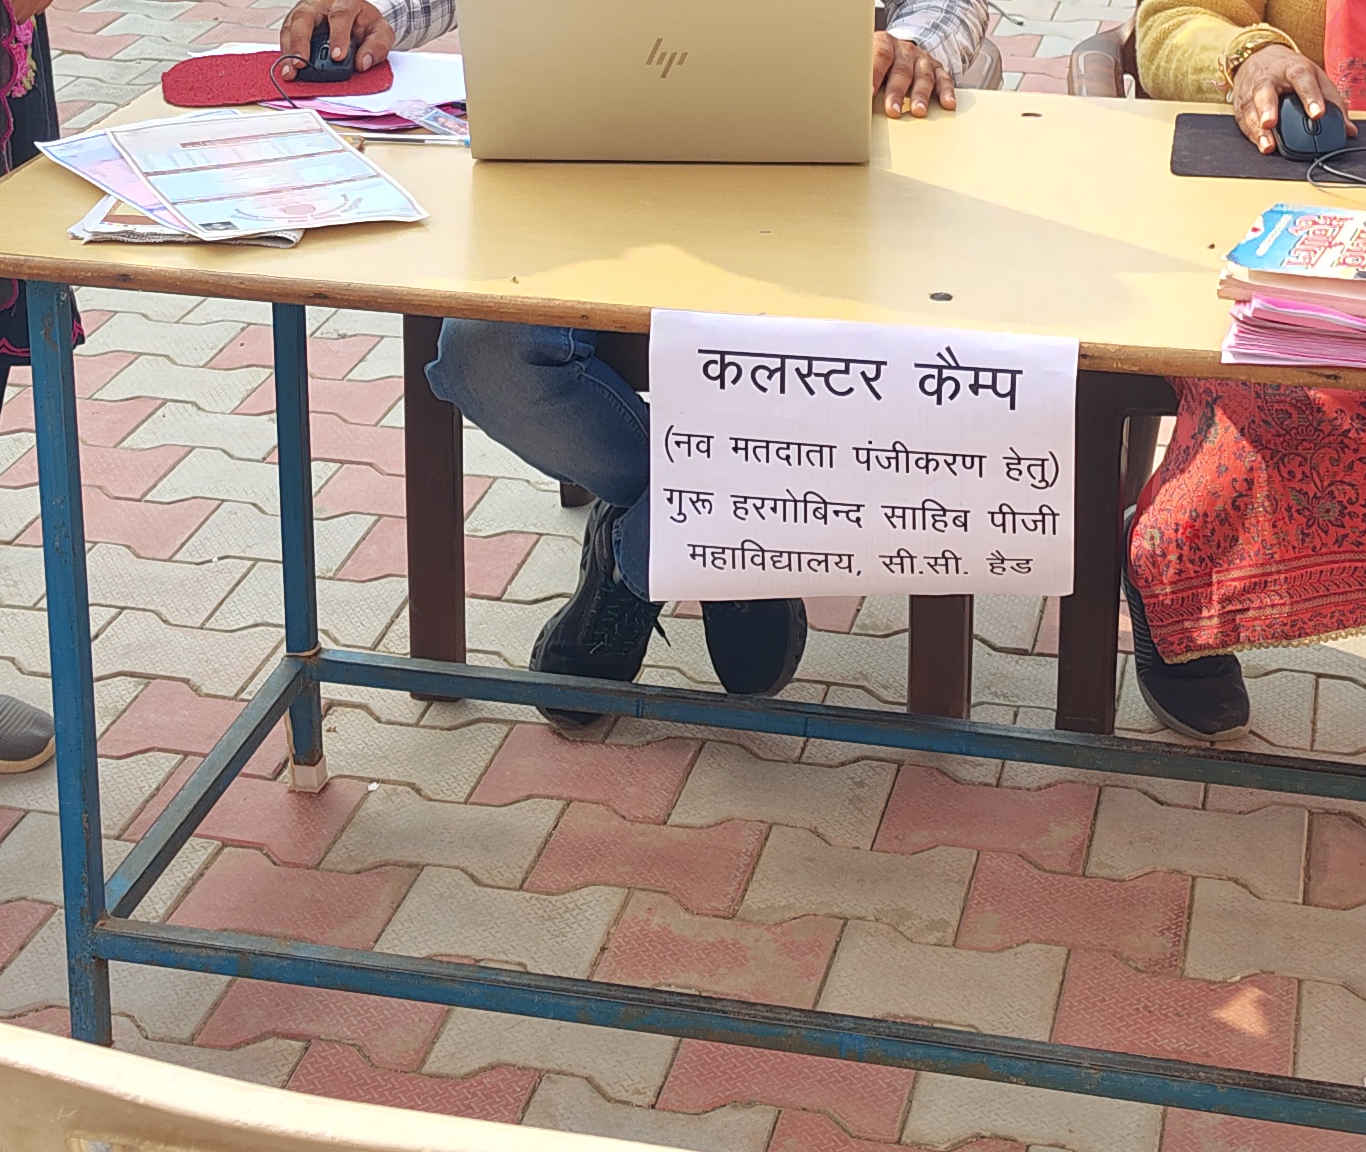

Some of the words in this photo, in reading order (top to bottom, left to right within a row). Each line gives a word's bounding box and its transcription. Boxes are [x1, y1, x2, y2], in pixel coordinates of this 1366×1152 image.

[645, 37, 689, 79] hp
[697, 348, 888, 401] कलस्टर
[914, 346, 1023, 411] कैम्प
[664, 424, 715, 463] (नव
[728, 436, 838, 469] मतदाता
[851, 440, 988, 478] पंजीकरण
[1002, 446, 1061, 490] हेतु)
[729, 488, 866, 529] हरगोबिन्द
[880, 498, 971, 533] साहिब
[987, 502, 1060, 536] पीजी
[687, 538, 863, 577] महाविद्यालय,
[878, 547, 969, 576] सी.सी.
[986, 549, 1034, 576] हैड
